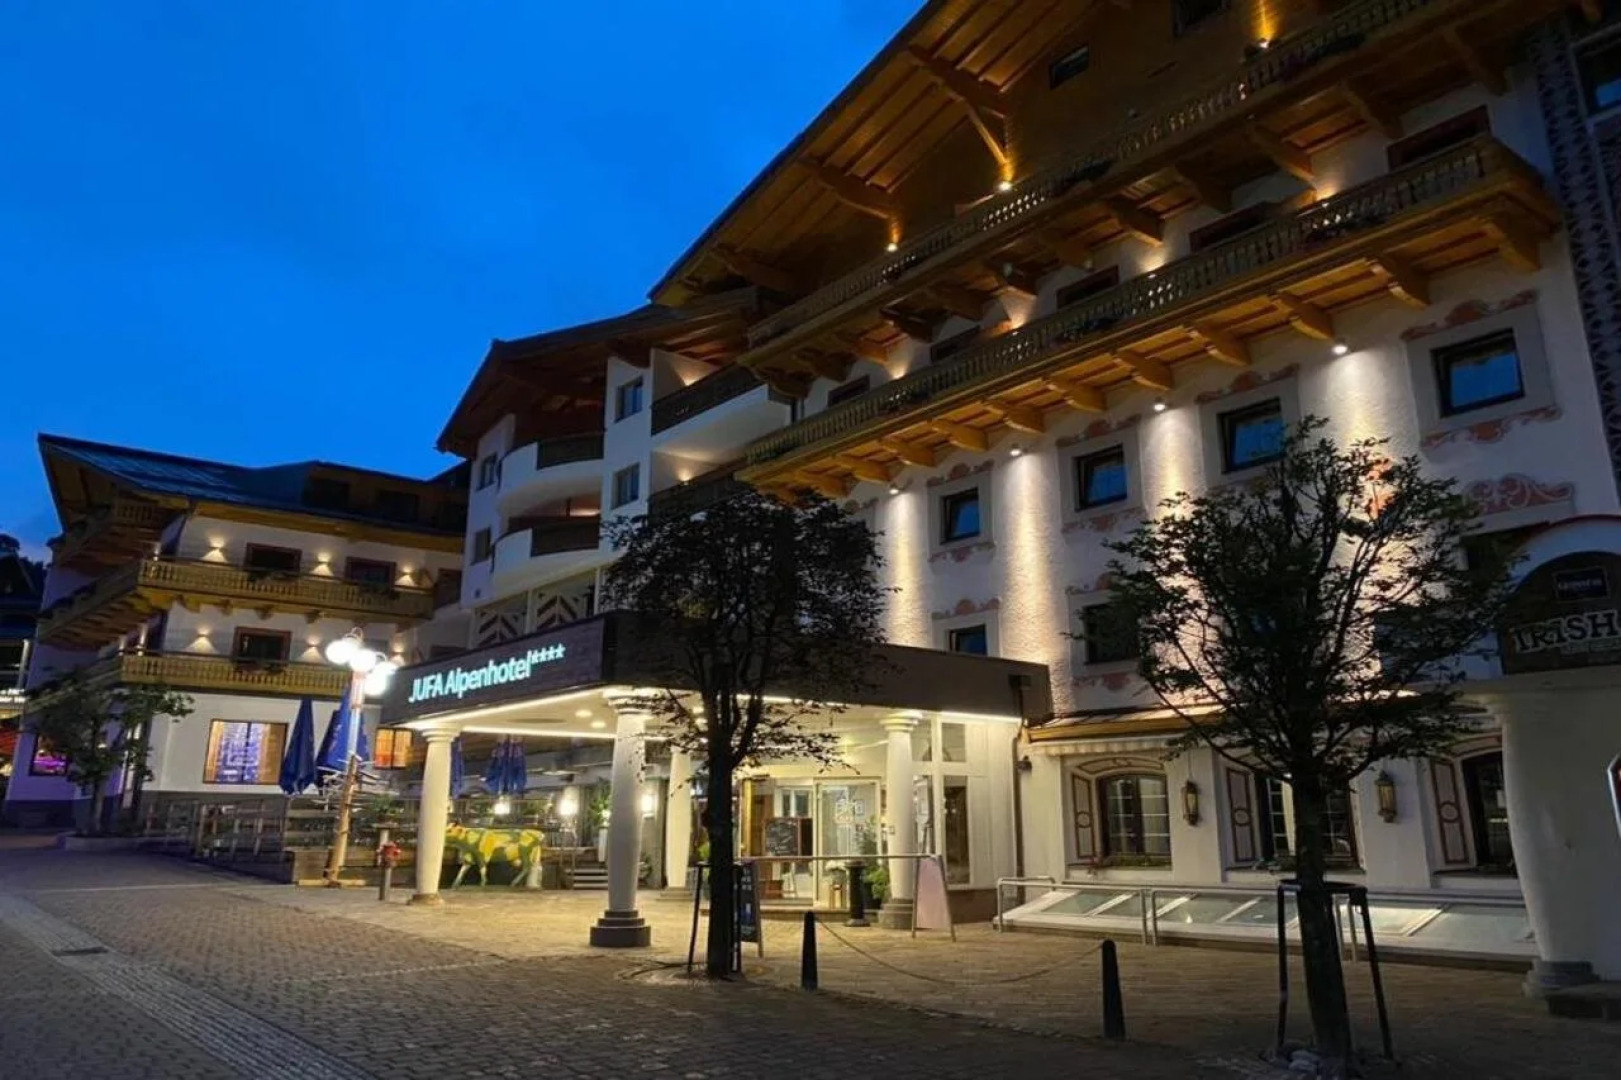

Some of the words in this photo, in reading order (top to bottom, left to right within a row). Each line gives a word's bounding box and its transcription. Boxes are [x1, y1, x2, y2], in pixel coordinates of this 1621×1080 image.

[1513, 610, 1619, 653] IRISH
[408, 672, 443, 703] JUFA
[444, 650, 532, 698] Alpenhotel
